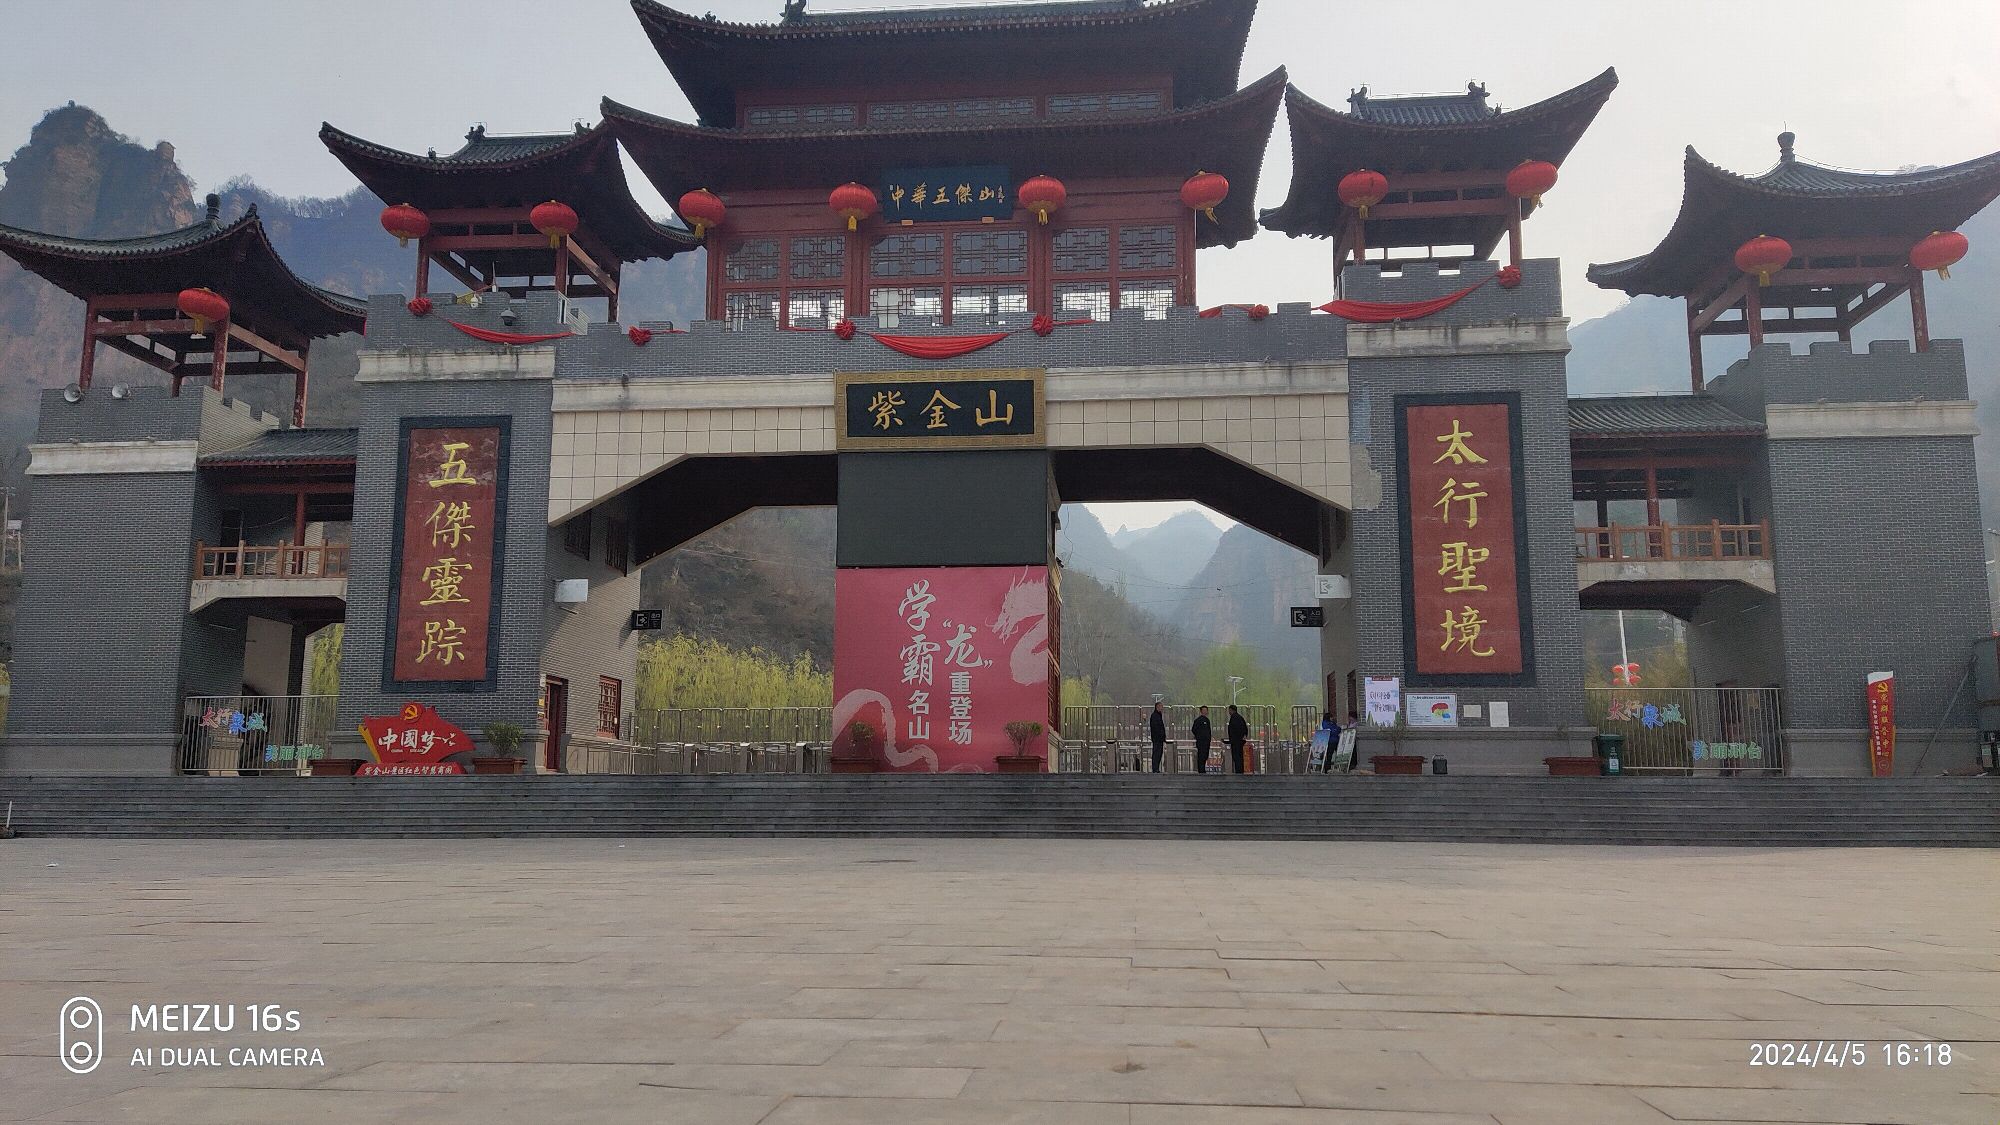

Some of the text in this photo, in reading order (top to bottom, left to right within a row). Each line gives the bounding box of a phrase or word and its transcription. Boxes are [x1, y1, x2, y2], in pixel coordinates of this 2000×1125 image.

[867, 388, 1014, 430] 紫金山
[415, 442, 477, 665] 五傑靈踪
[1433, 419, 1496, 657] 太行聖境
[898, 579, 940, 740] 学霸名山
[199, 706, 268, 735] 太行泉城
[1606, 697, 1687, 730] 太行泉城
[265, 743, 325, 762] 美丽邢台
[1692, 739, 1763, 760] 美丽邢台
